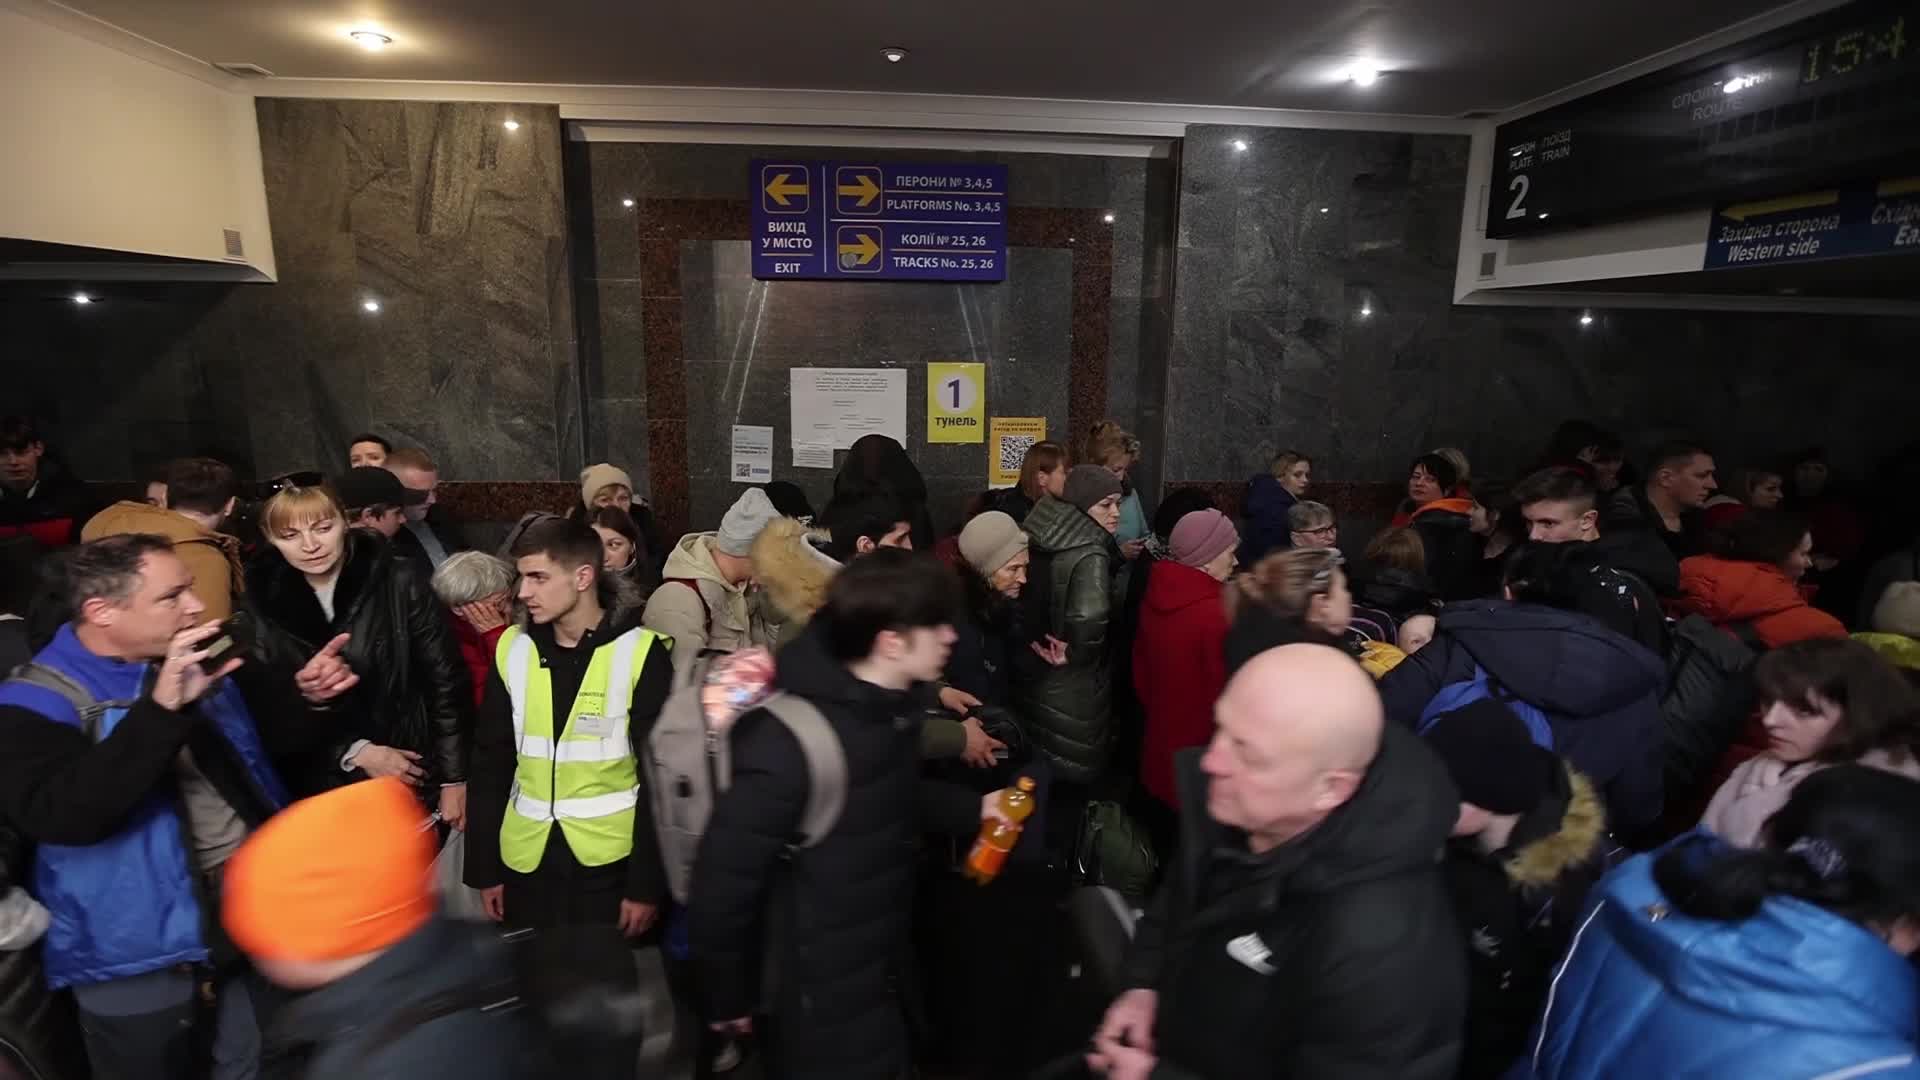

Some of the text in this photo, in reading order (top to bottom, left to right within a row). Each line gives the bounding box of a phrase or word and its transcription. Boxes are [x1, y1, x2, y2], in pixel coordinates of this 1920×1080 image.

[1692, 98, 1743, 121] ROUTE
[1541, 143, 1571, 161] TRAIN
[895, 175, 993, 190] ПЕРОНИ № 3,4,5
[1504, 174, 1530, 220] 2
[887, 199, 1001, 213] PLATFORMS No. 3,4,5
[768, 221, 807, 235] ВИХІД
[1718, 214, 1841, 244] Західна сторона
[762, 237, 813, 249] У МІСТО
[901, 232, 987, 247] КОЛІЇ № 25, 26
[1728, 236, 1820, 263] Western side
[774, 262, 801, 273] EXIT
[893, 256, 994, 270] TRACKS No. 25, 26
[947, 378, 960, 409] 1
[935, 416, 978, 429] тунель
